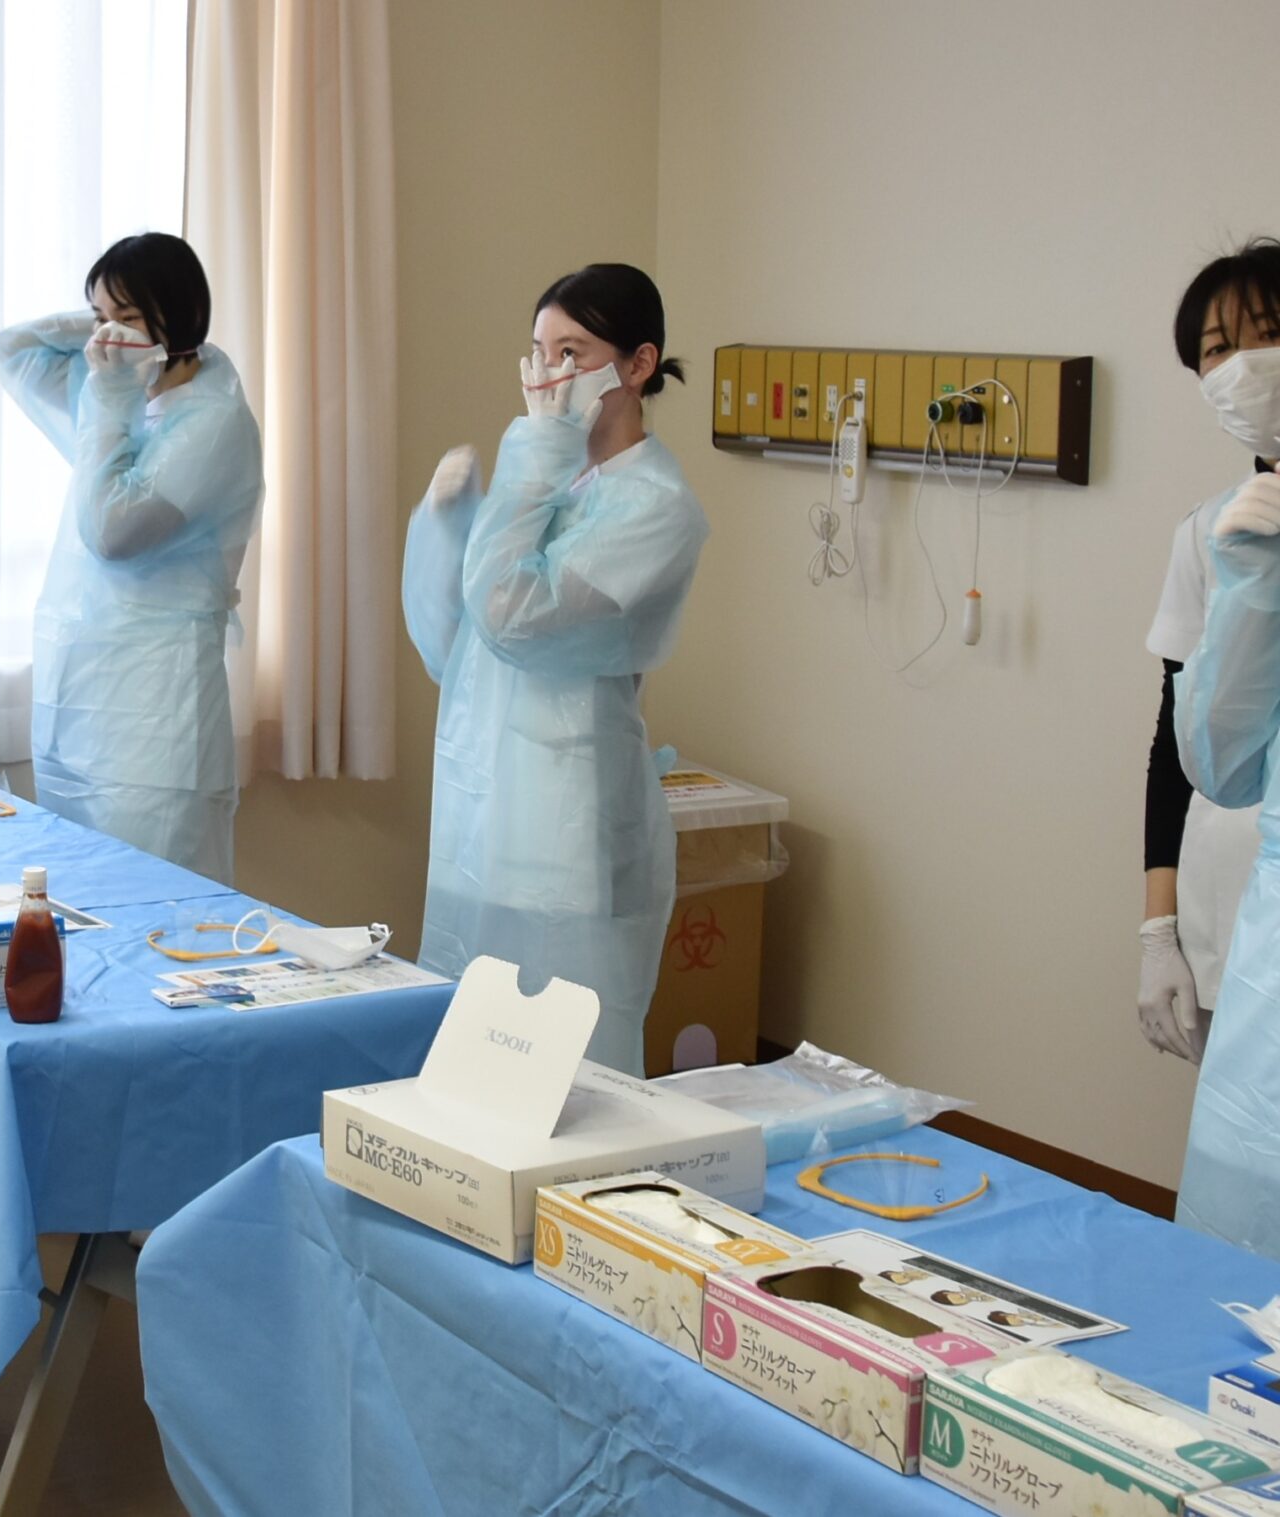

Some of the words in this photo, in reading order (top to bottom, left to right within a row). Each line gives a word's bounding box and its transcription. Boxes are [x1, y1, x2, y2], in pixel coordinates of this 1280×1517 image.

[484, 1028, 533, 1054] HOGY
[364, 1133, 468, 1185] メディカルキャップ
[364, 1146, 423, 1186] MC-E60
[538, 1219, 557, 1256] XS
[567, 1246, 629, 1285] ニトリルグローブ
[567, 1262, 615, 1295] ソフトフィット
[707, 1284, 737, 1307] SARAYA
[711, 1312, 725, 1346] S
[741, 1337, 816, 1384] ニトリルグローブ
[741, 1354, 798, 1395] ソフトフィット
[928, 1383, 965, 1409] SARAYA
[1230, 1398, 1256, 1418] Osaki
[929, 1411, 952, 1455] M
[970, 1444, 1063, 1498] ニトリルグローブ
[970, 1463, 1040, 1509] ソフトフィット
